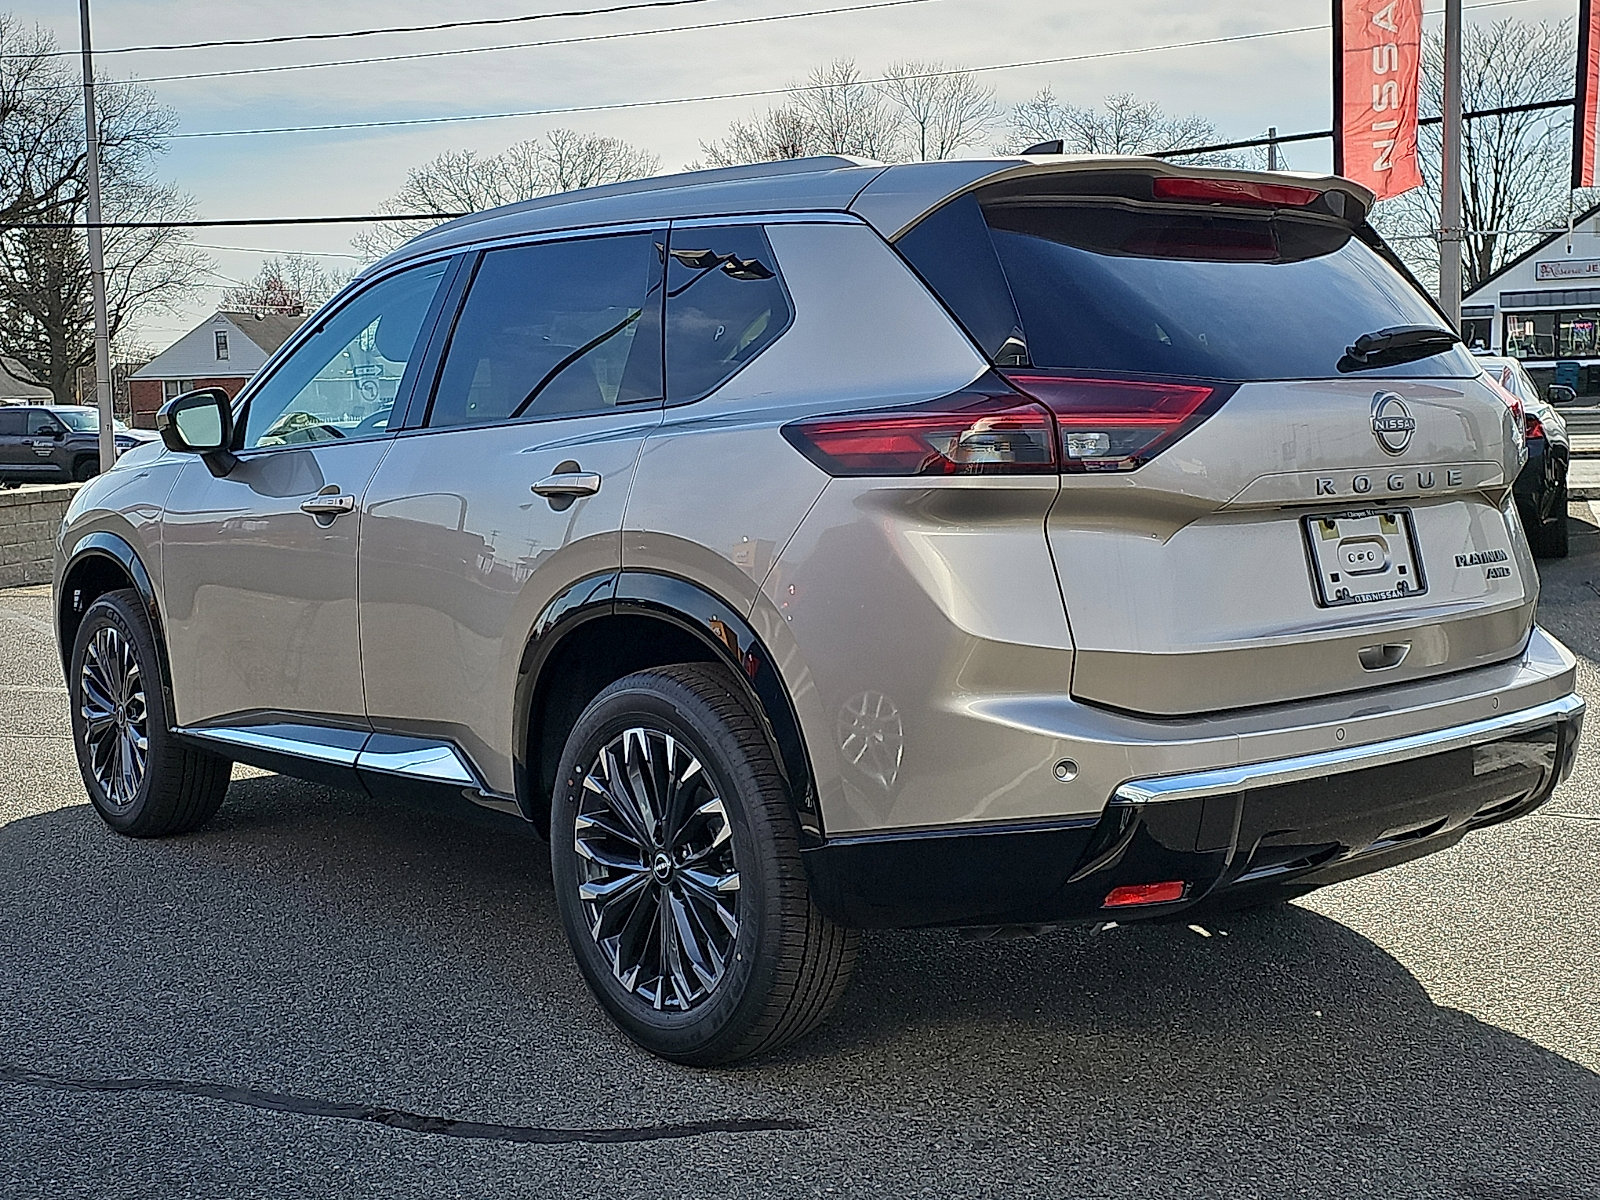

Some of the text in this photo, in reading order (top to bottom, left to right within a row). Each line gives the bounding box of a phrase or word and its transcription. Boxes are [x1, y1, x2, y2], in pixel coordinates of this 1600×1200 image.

[1375, 419, 1415, 430] NISSAN
[1316, 469, 1463, 496] ROGUE
[1454, 550, 1509, 568] PLATINUM
[1486, 566, 1511, 580] AWD
